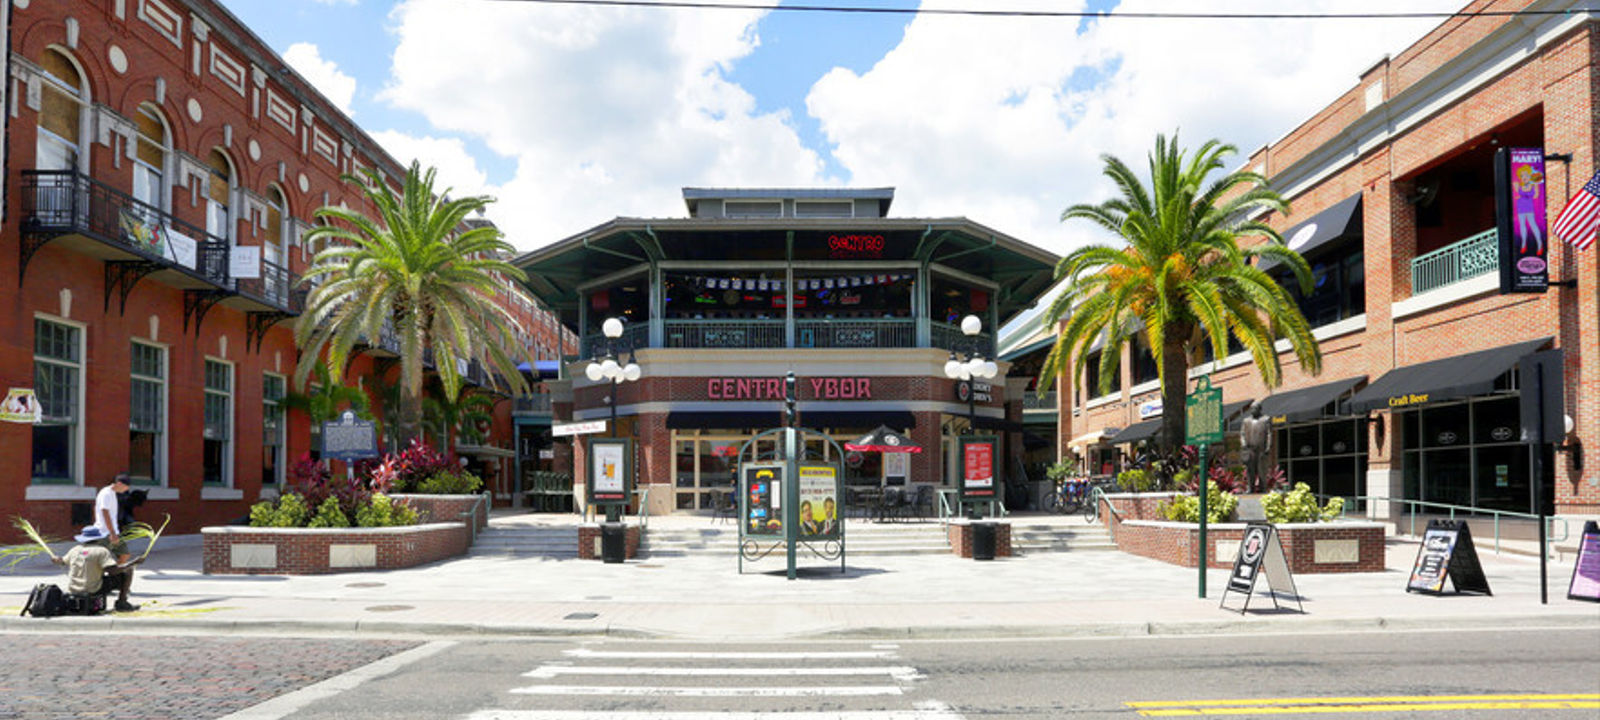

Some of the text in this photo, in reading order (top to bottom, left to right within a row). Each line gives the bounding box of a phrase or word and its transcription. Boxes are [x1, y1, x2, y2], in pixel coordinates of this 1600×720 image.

[811, 377, 872, 399] YBOR
[1388, 393, 1429, 407] Craft Beer
